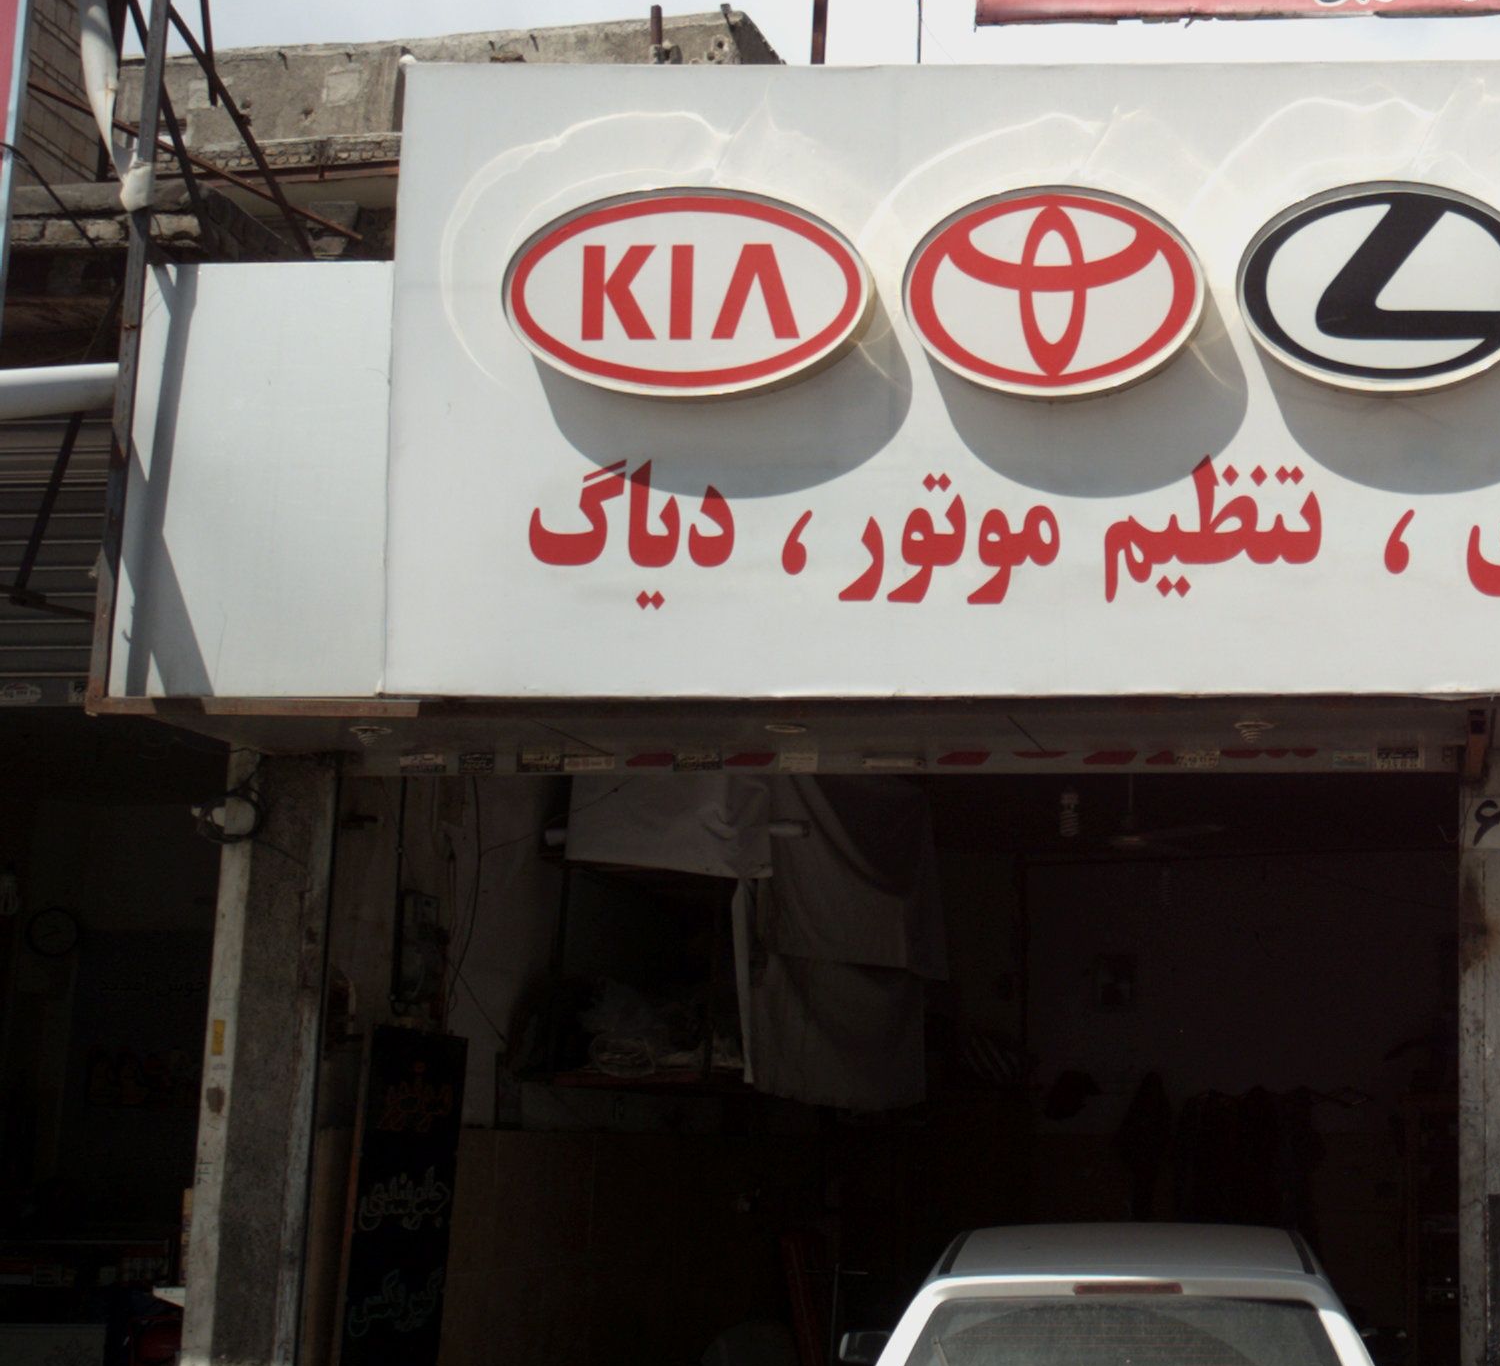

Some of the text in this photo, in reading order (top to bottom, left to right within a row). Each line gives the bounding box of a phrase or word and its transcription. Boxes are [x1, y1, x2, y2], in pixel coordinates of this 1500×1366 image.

[580, 243, 800, 341] KIA
[528, 460, 736, 609] دیاگ
[1103, 456, 1323, 604] تنظیم
